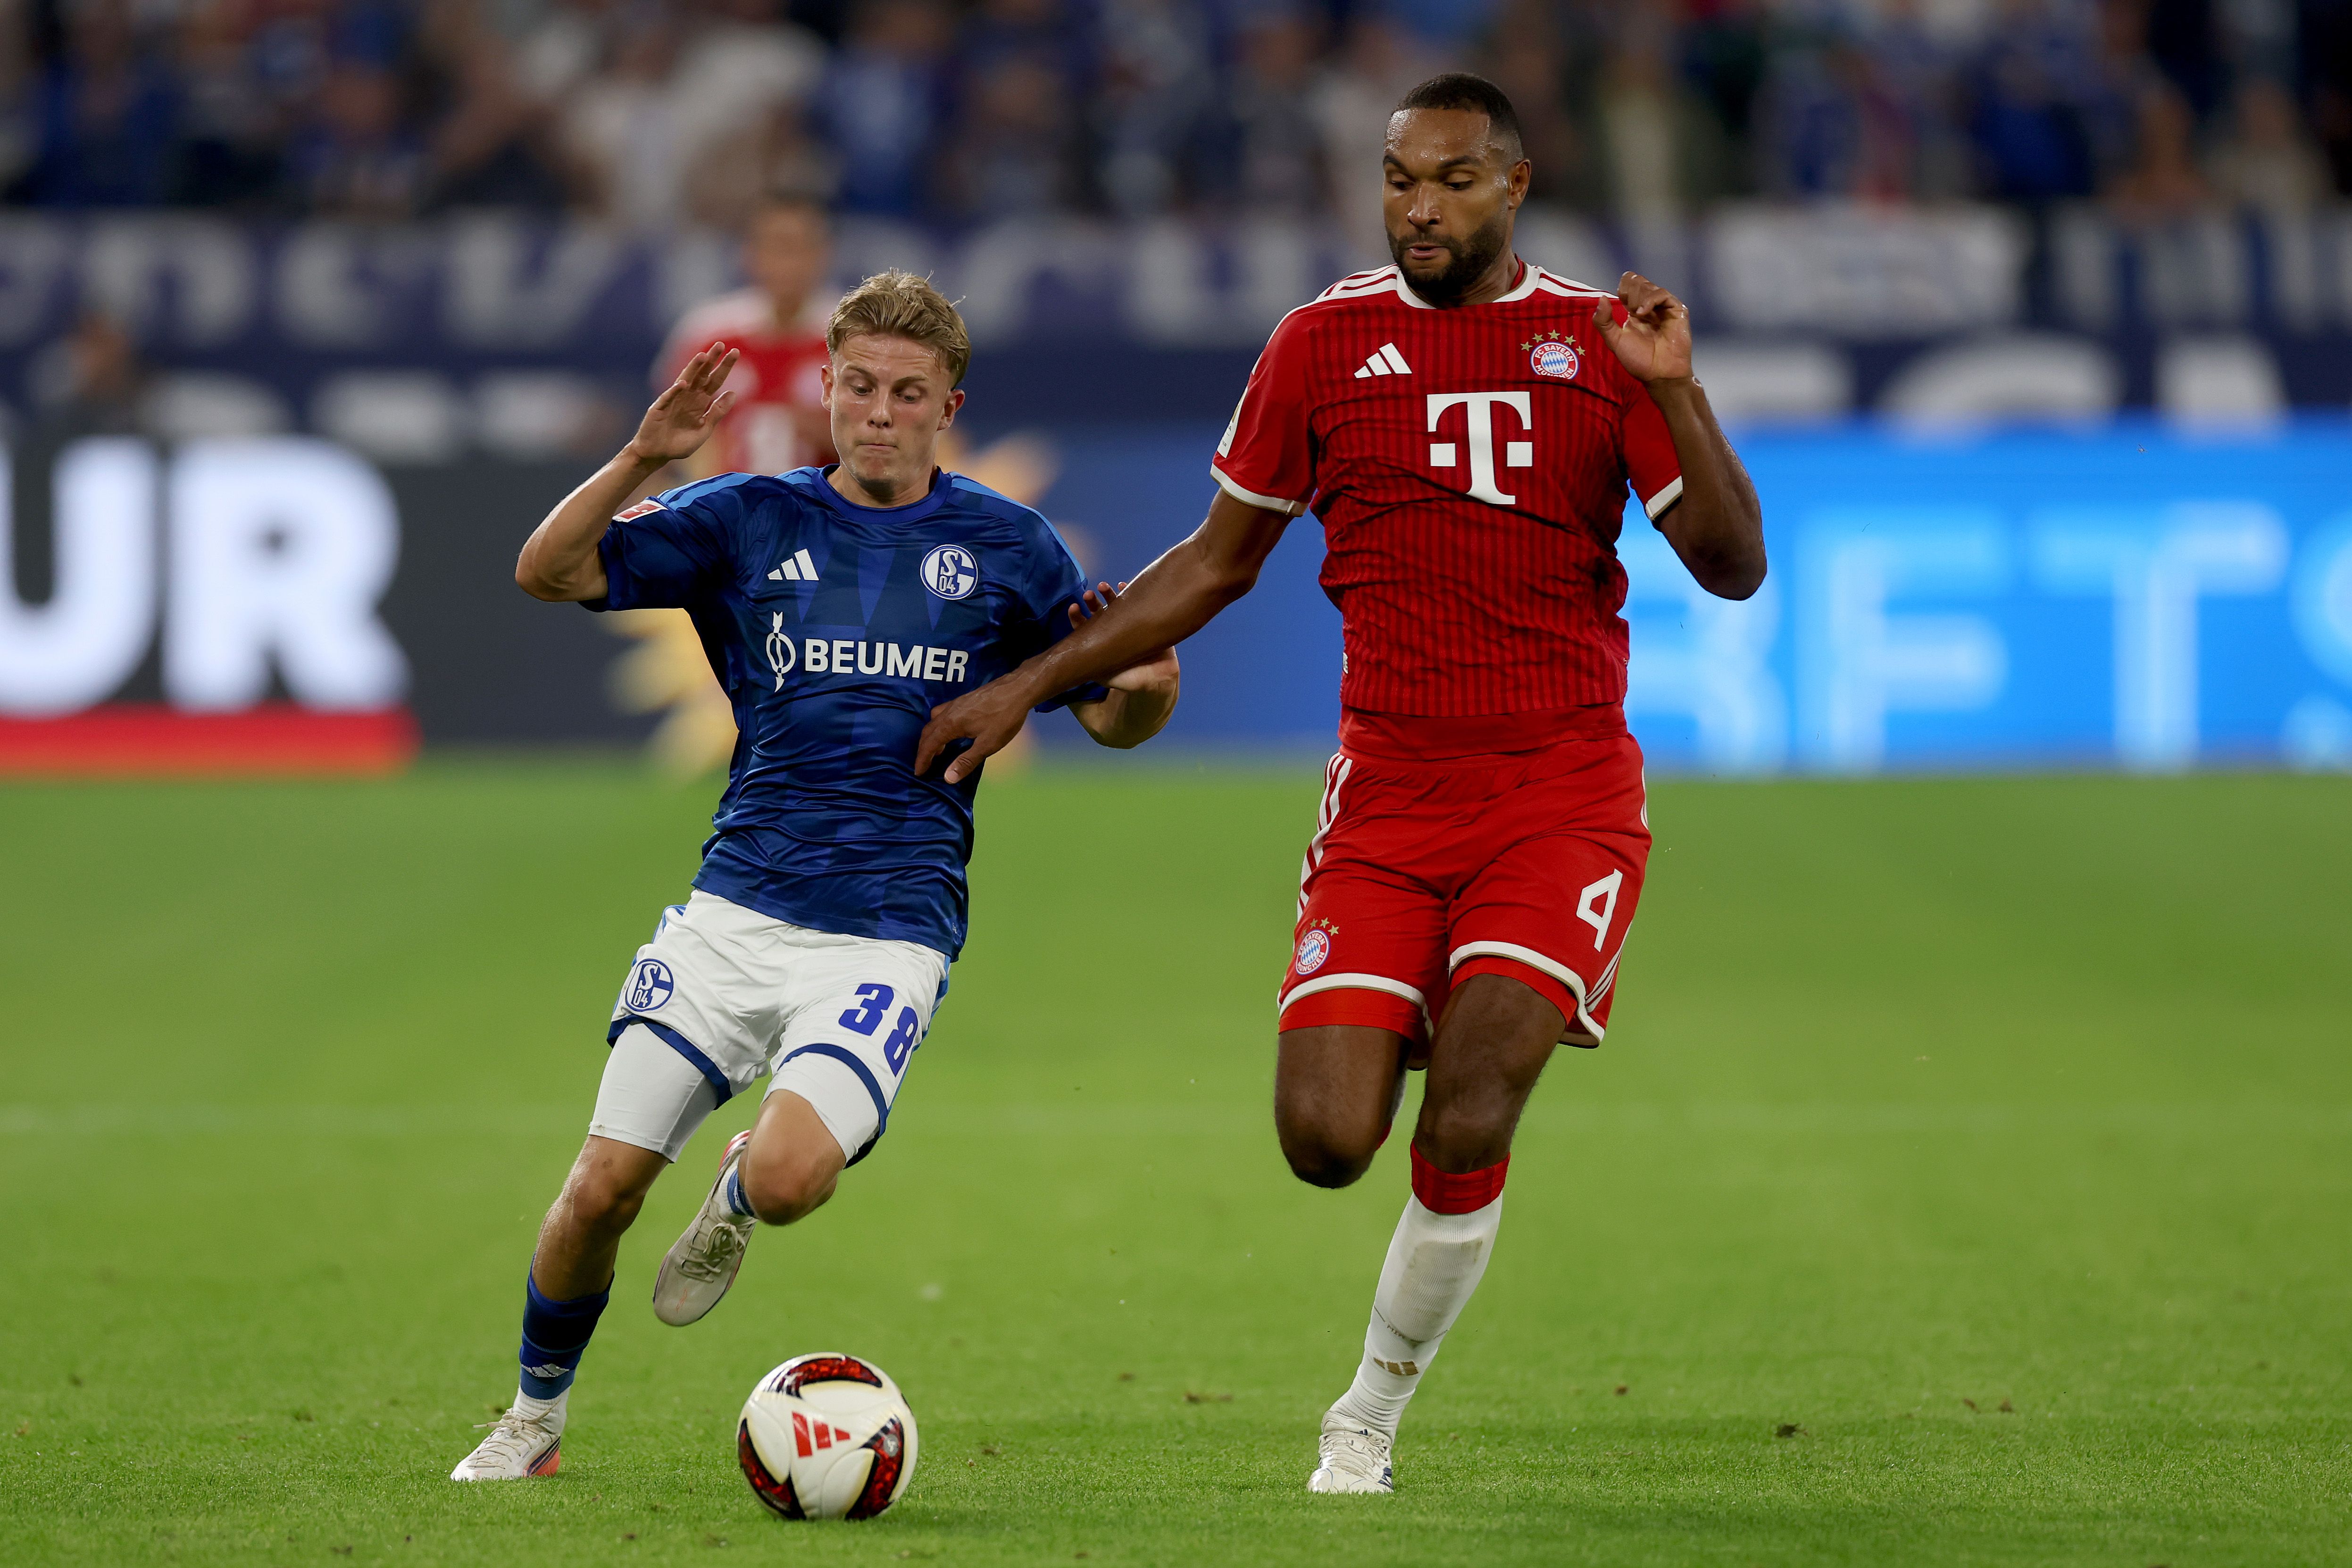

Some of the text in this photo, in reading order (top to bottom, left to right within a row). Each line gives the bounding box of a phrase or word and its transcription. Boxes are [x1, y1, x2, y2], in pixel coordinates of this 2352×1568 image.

[1535, 345, 1575, 362] FC BAYERN
[1427, 392, 1532, 505] T
[805, 639, 969, 683] BEUMER
[1576, 868, 1623, 953] 4
[838, 984, 918, 1078] 38
